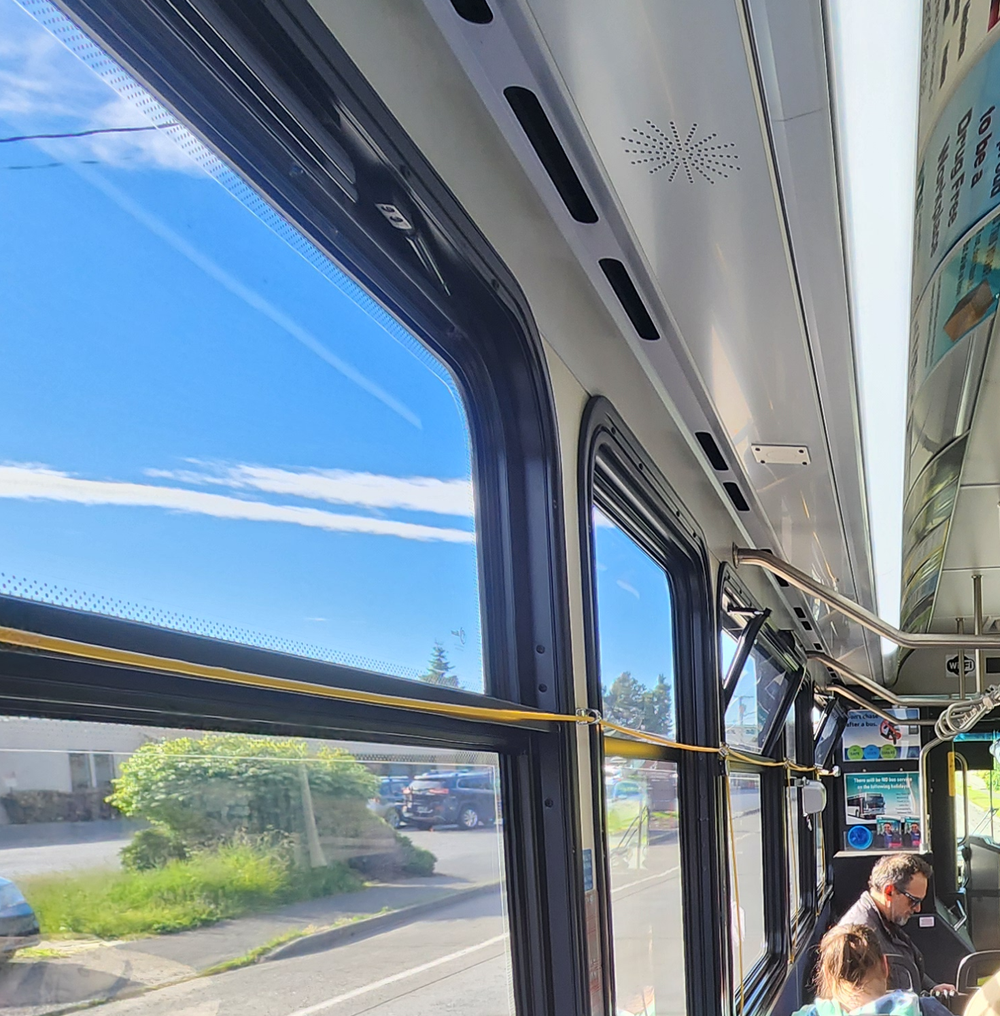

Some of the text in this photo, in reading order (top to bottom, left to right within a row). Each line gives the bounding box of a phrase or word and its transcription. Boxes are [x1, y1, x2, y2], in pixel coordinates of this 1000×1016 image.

[951, 107, 973, 181] Drug
[970, 105, 995, 188] to be a
